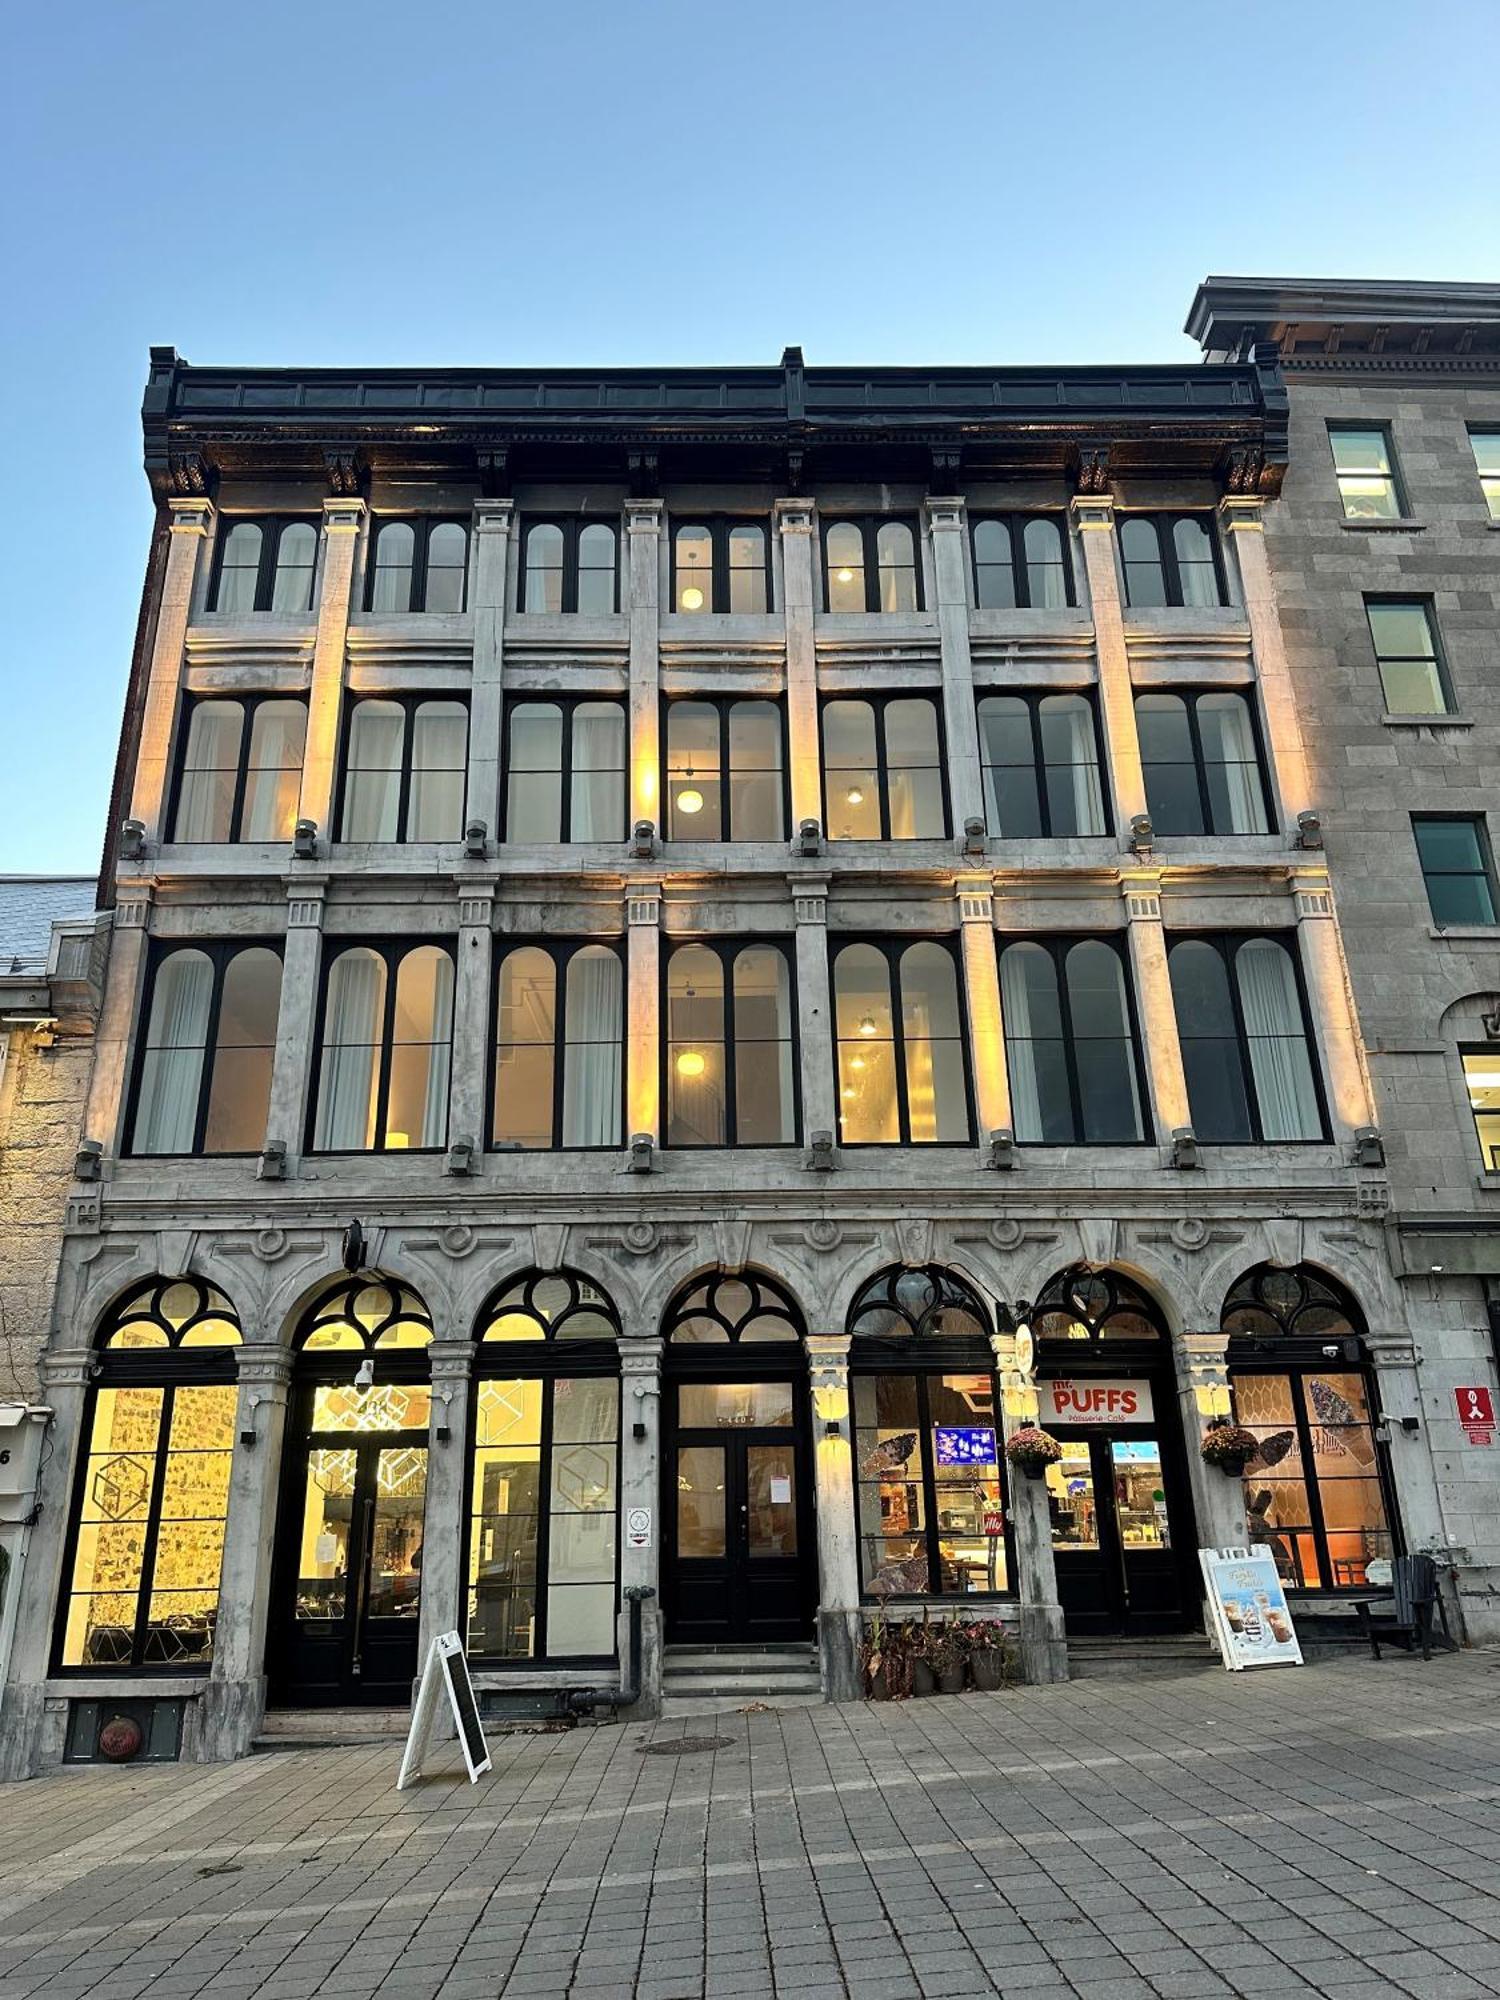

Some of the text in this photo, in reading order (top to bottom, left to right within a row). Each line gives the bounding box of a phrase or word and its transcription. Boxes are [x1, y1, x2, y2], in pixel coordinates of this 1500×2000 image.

[1052, 1380, 1073, 1390] mr.
[1053, 1389, 1137, 1414] PUFFS
[0, 1449, 11, 1465] 6
